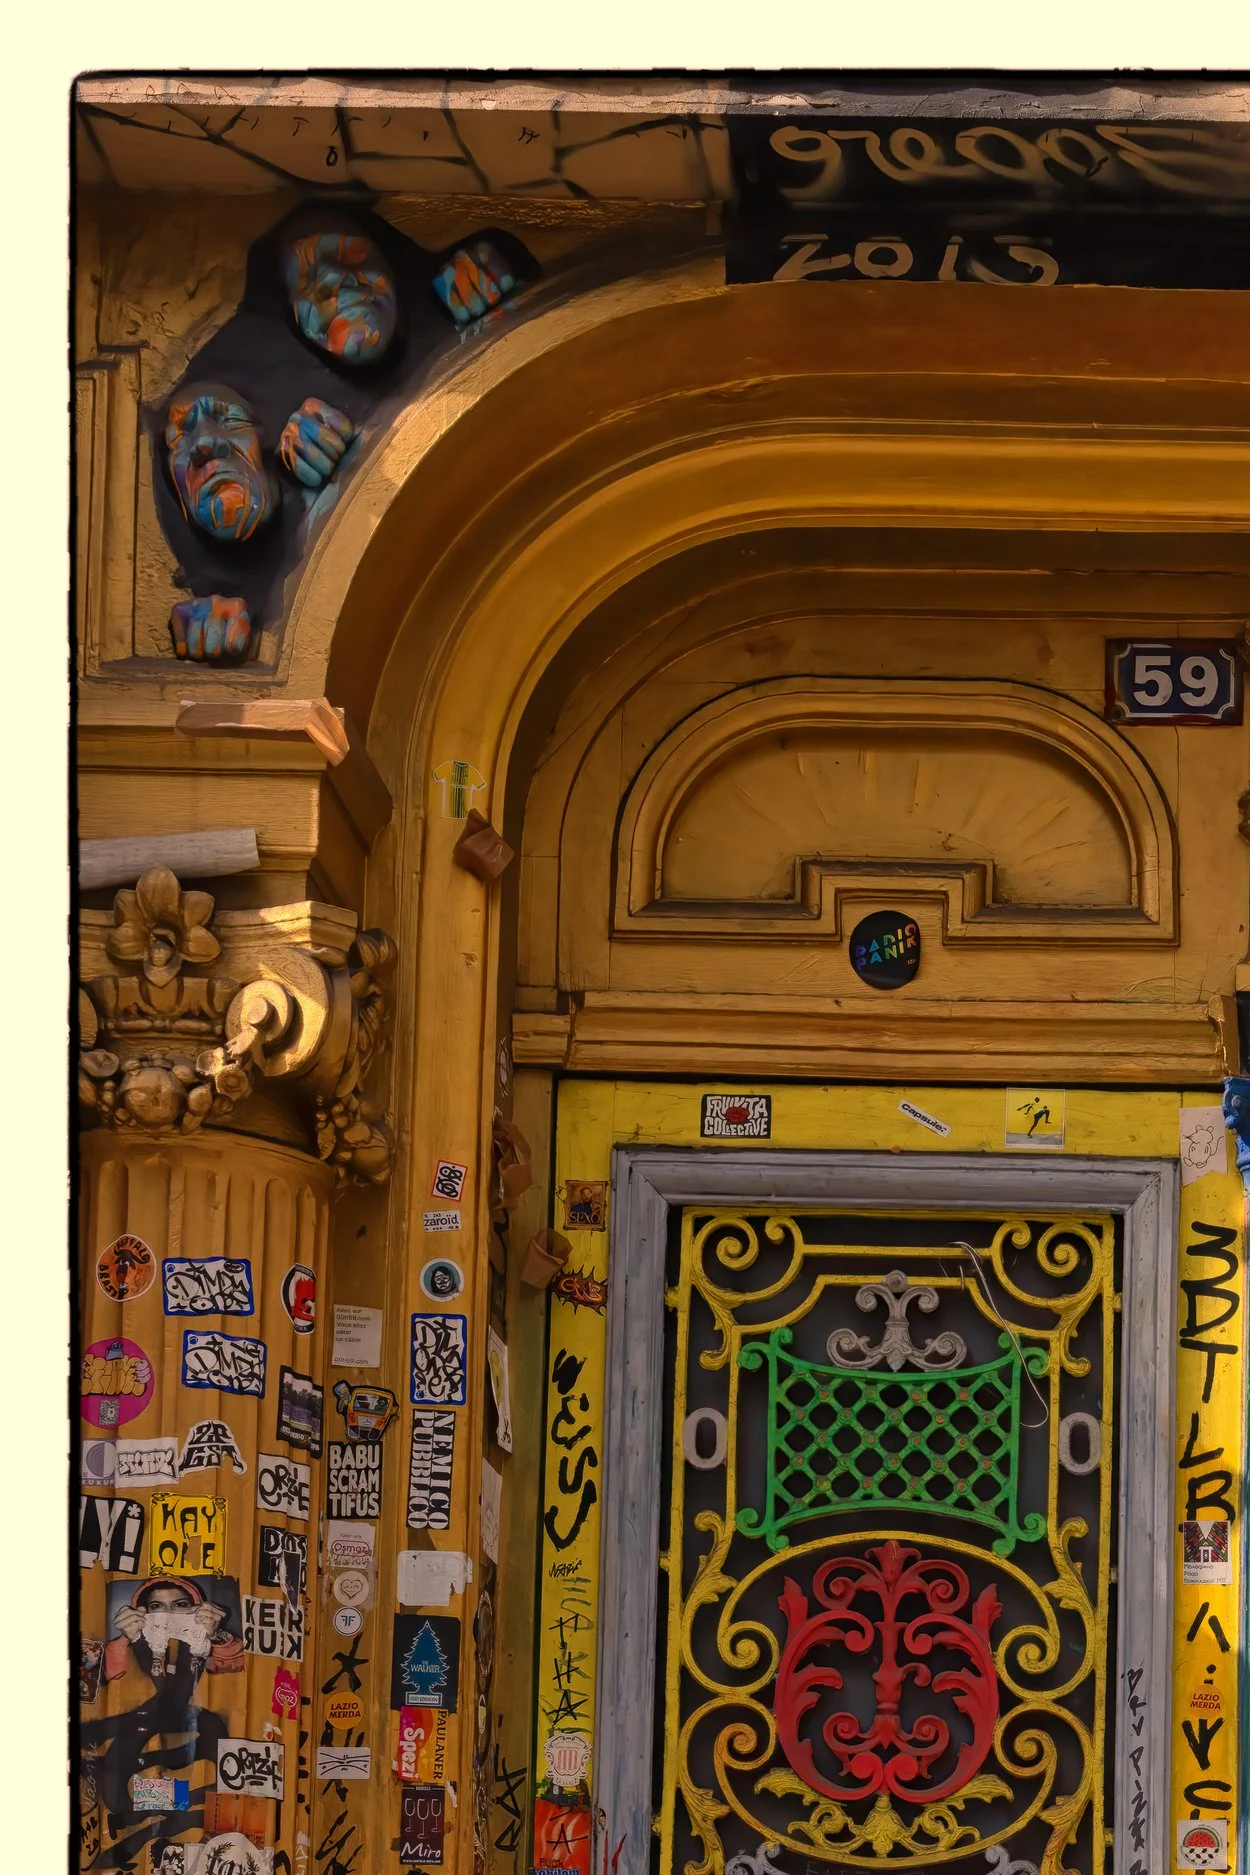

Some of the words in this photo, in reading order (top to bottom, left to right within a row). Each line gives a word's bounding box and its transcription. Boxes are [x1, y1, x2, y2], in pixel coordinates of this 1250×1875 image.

[1132, 656, 1220, 707] 59
[330, 1445, 381, 1468] BABU
[329, 1470, 381, 1493] SCRAM
[408, 1411, 433, 1529] PUBBLICO
[429, 1412, 455, 1529] NEMICO
[329, 1495, 380, 1517] TIFUS
[161, 1503, 217, 1534] KAY
[410, 1662, 441, 1675] WALKER
[330, 1702, 359, 1711] LAZIO
[1190, 1701, 1221, 1710] MERDA
[1193, 1693, 1220, 1702] LAZIO
[328, 1710, 361, 1720] MERDA
[401, 1727, 424, 1779] Spezi
[433, 1710, 447, 1780] PAULANER
[402, 1842, 441, 1859] Miro
